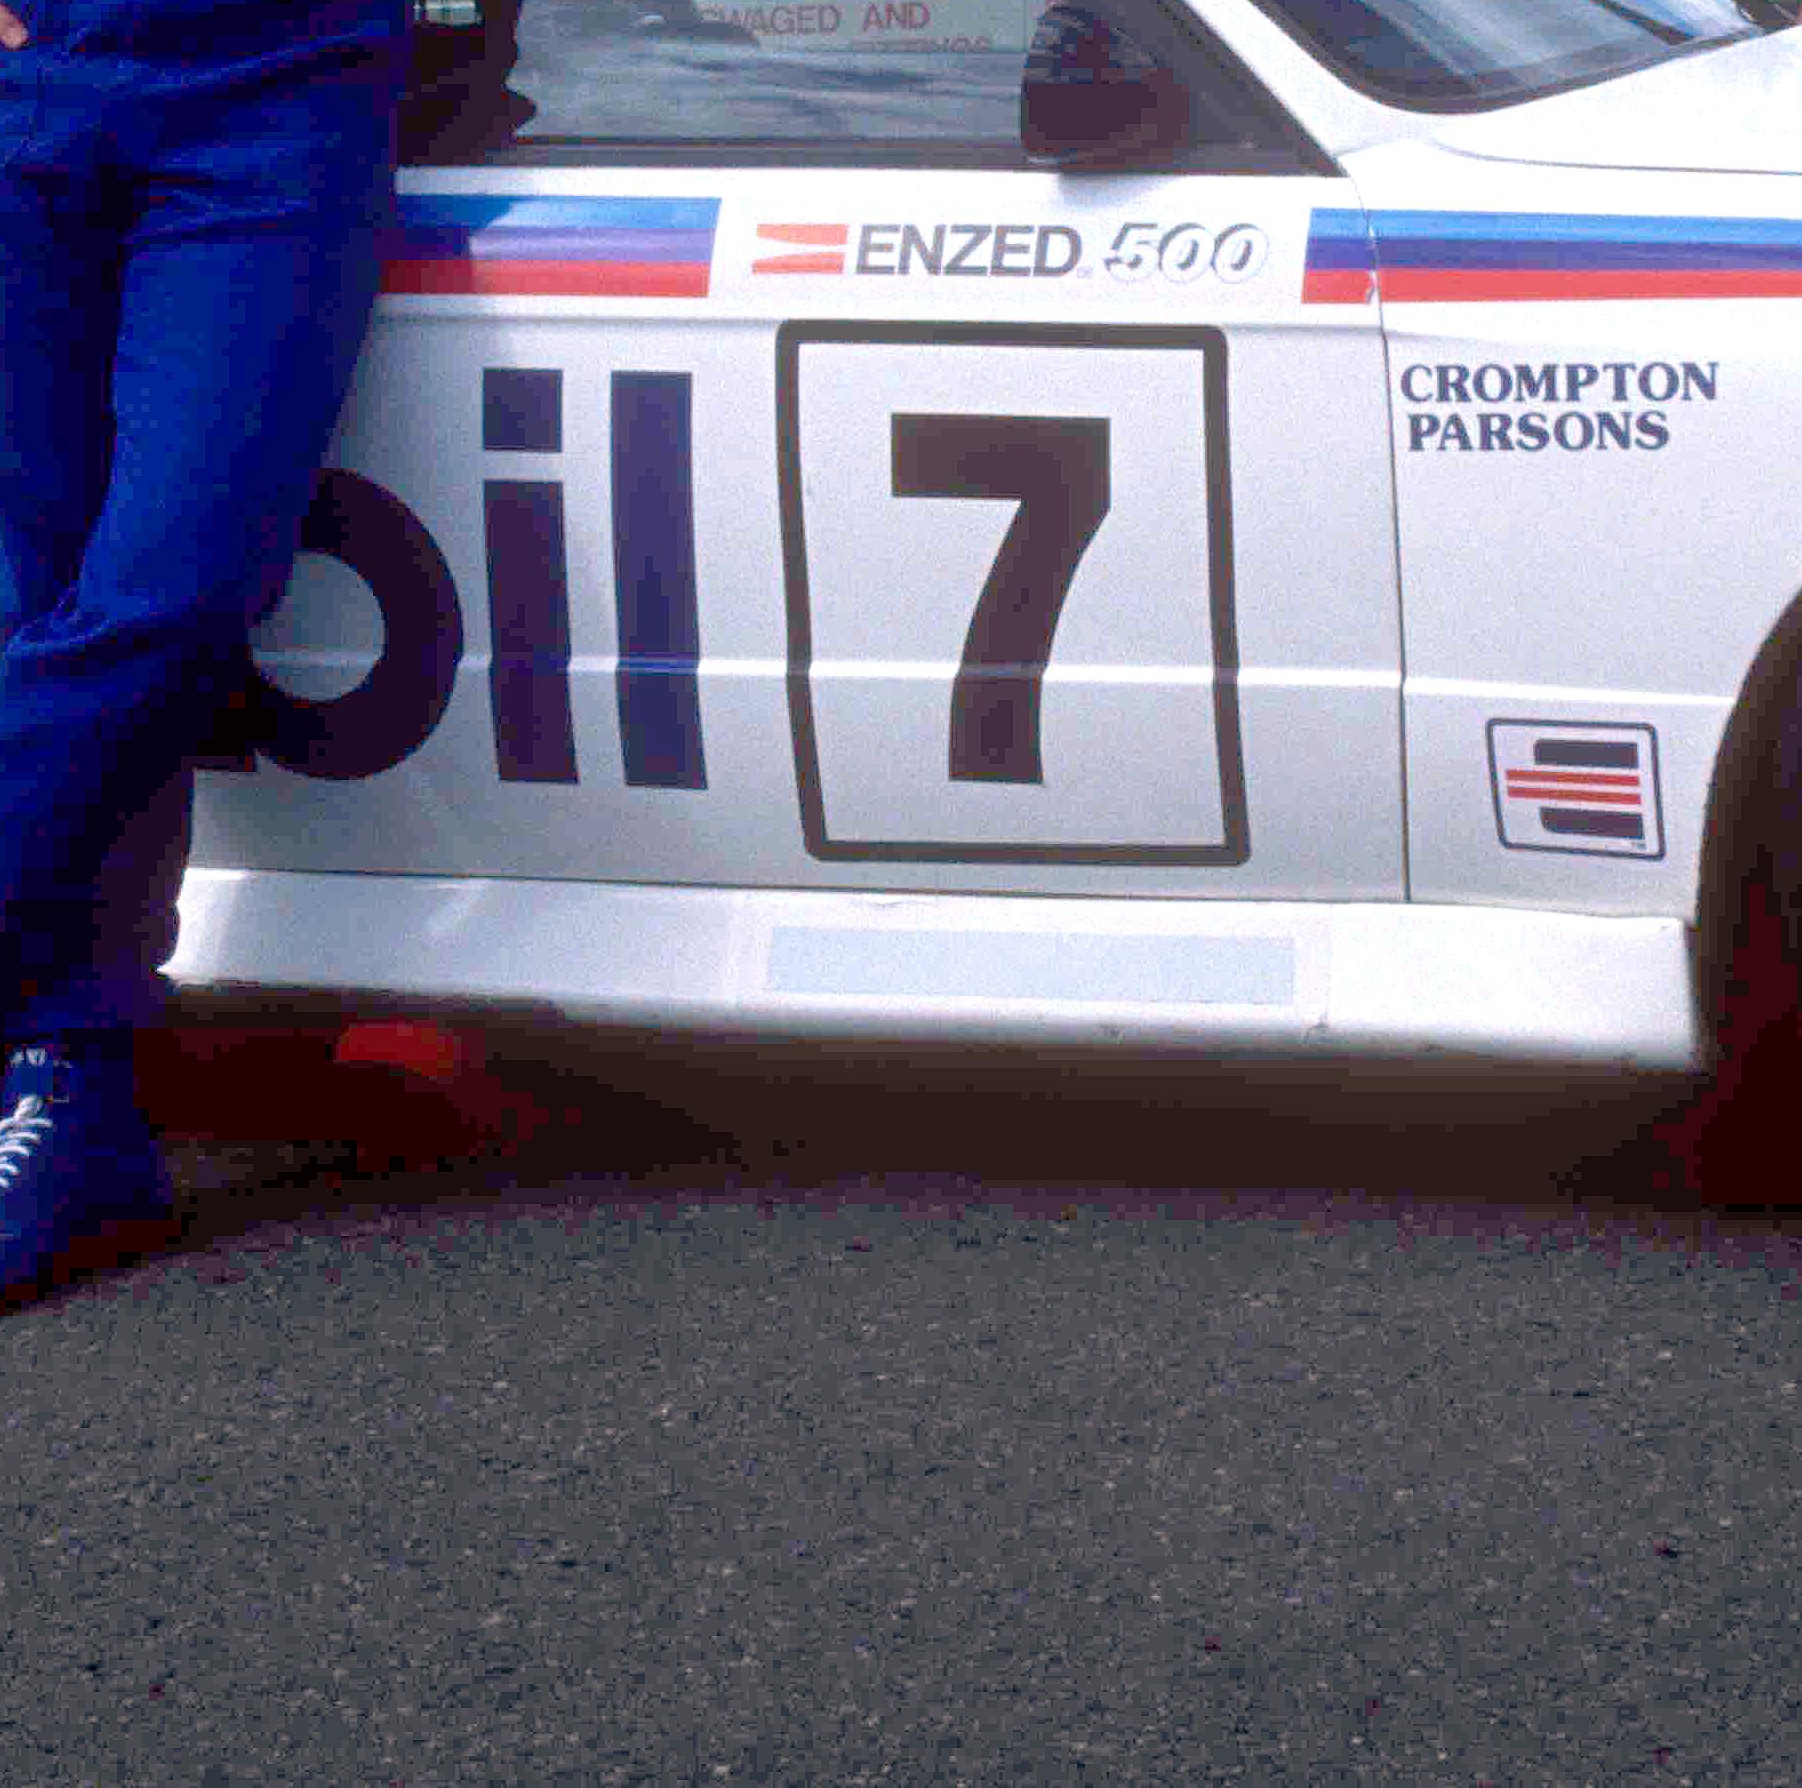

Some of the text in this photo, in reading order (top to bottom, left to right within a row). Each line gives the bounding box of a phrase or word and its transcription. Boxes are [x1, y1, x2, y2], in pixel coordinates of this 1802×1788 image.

[862, 1, 931, 32] AND
[855, 220, 1272, 286] ENZED 500
[1399, 360, 1720, 403] CROMPTON
[1407, 410, 1670, 452] PARSONS
[891, 411, 1111, 786] 7
